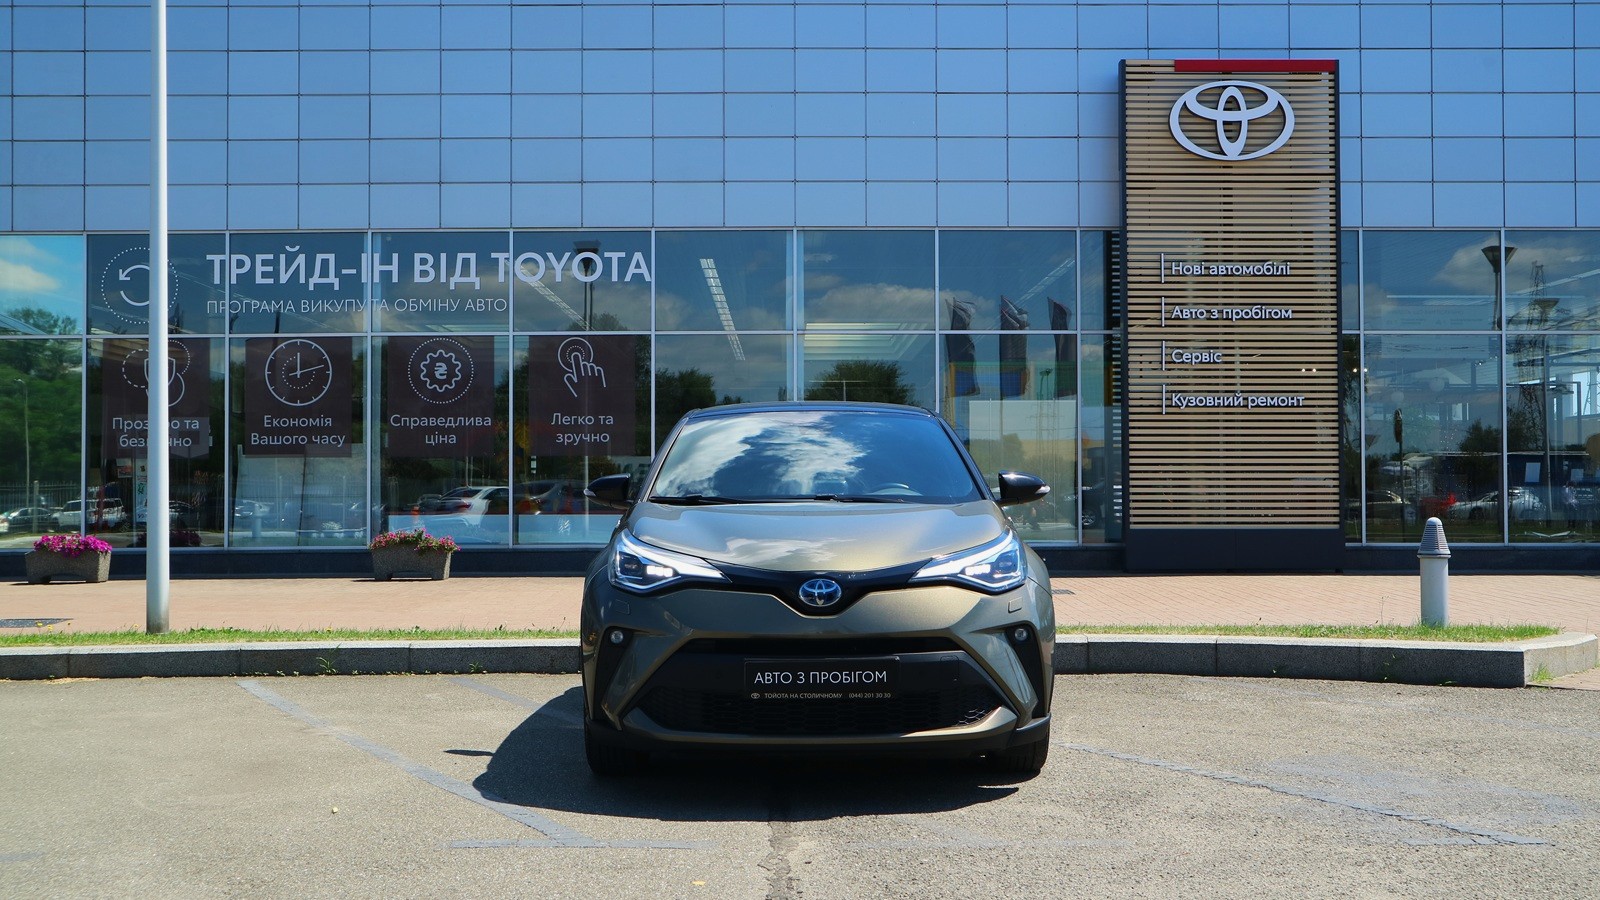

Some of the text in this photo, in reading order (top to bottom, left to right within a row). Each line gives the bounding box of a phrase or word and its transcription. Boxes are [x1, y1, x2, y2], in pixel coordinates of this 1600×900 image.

[206, 245, 652, 291] ТРЕЙД-ІН ВІД TOYOTA
[1171, 261, 1291, 276] Нові автомобілі
[206, 298, 508, 314] ПРОГРАМА ВИКУПУ ТА ОБМІНУ АВТО
[1171, 305, 1293, 322] Авто з пробігом
[1171, 350, 1223, 365] Сервіс
[1171, 393, 1305, 410] Кузовний ремонт
[112, 417, 200, 433] Прозо та
[263, 414, 333, 428] Економія
[389, 413, 492, 430] Справедлива
[550, 412, 614, 426] Легко та
[250, 431, 346, 448] Вашого часу
[424, 430, 457, 446] ціна
[555, 432, 610, 447] зручно
[754, 671, 792, 684] АВТО
[810, 670, 887, 684] ПРОБІГОМ
